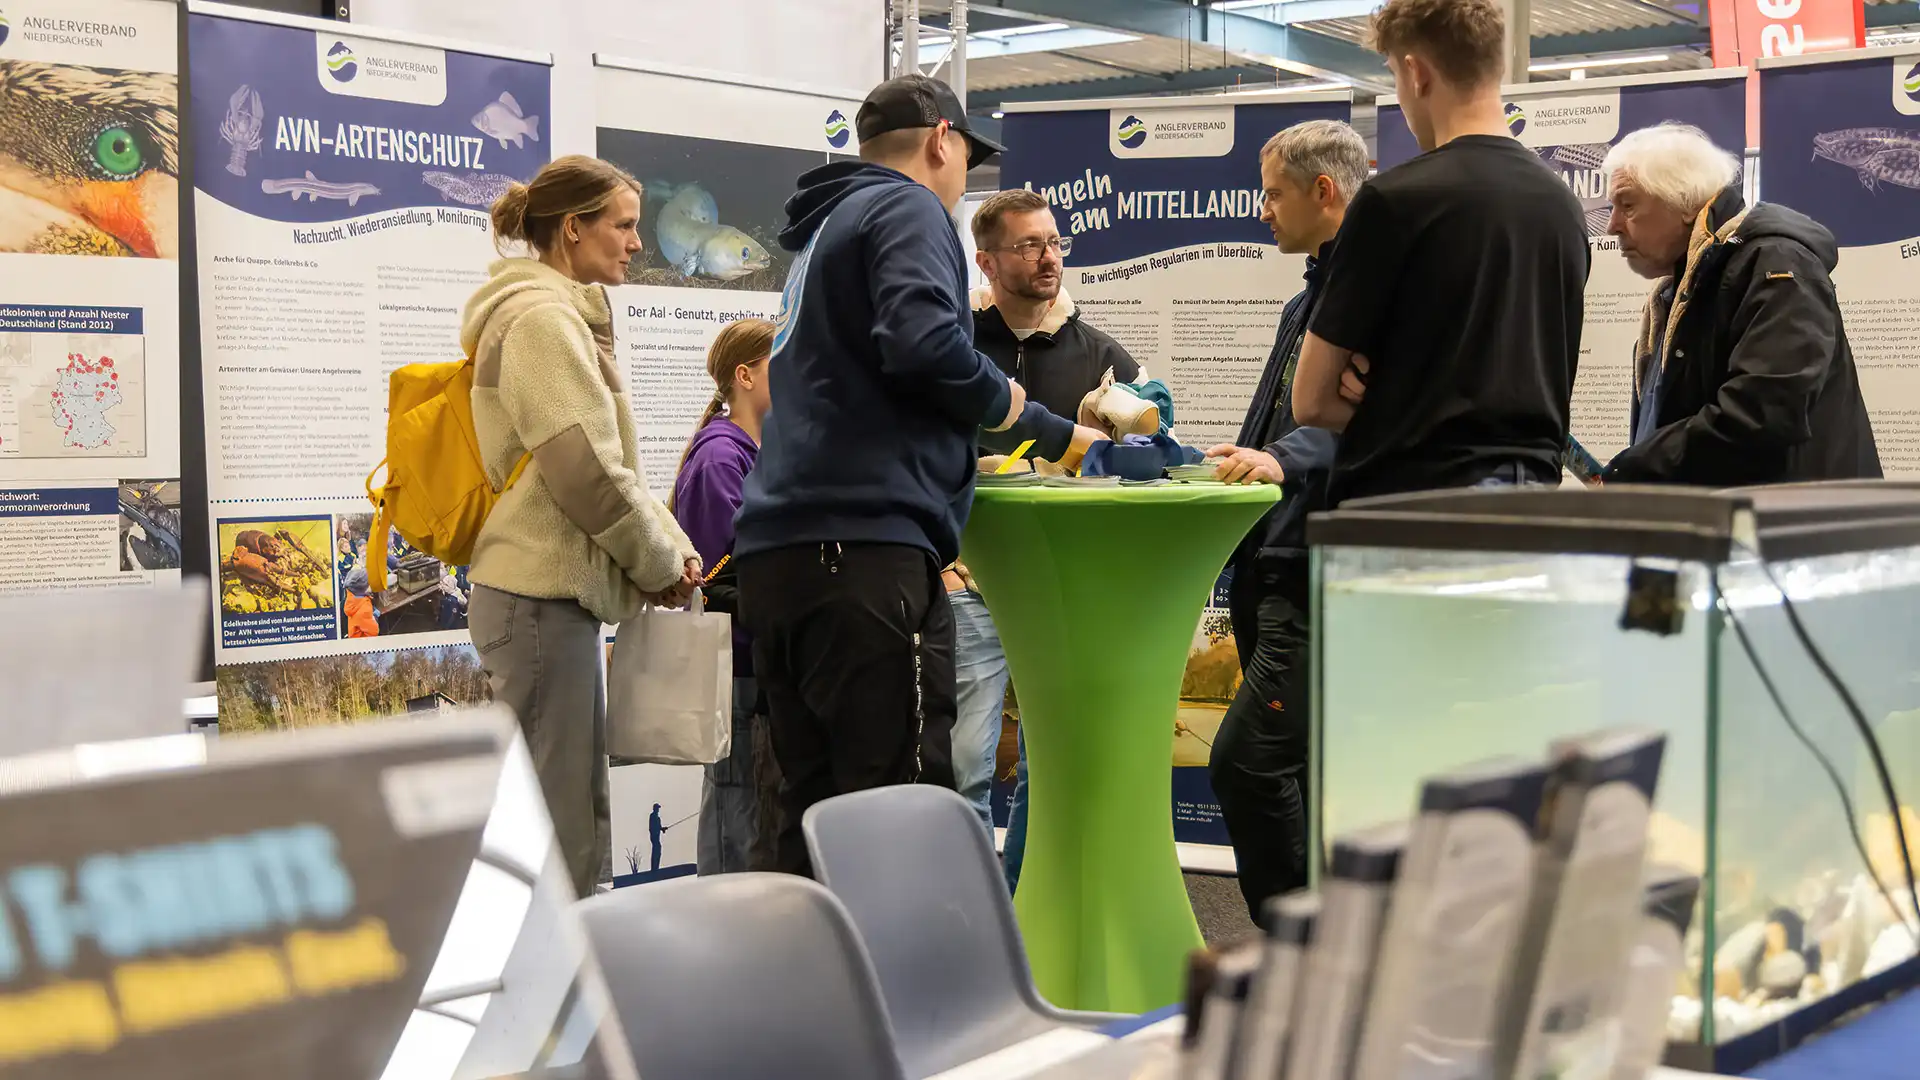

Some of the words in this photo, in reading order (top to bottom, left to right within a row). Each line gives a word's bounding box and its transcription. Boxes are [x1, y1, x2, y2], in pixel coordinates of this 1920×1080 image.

[23, 17, 137, 38] ANGLERVERBAND
[23, 32, 103, 47] NIEDERSACHSEN
[366, 56, 438, 75] ANGLERVERBAND
[366, 68, 417, 82] NIEDERSACHSEN
[1534, 105, 1611, 119] ANGLERVERBAND
[1154, 121, 1226, 132] ANGLERVERBAND
[1533, 118, 1587, 128] NIEDERSACHSEN
[1154, 132, 1204, 140] NIEDERSACHSEN
[275, 116, 485, 170] AVN-ARTENSCHUTZ
[437, 208, 488, 232] Monitoring
[1070, 206, 1110, 235] am
[213, 255, 234, 264] Arche
[274, 259, 303, 267] Edelkrebs
[1081, 272, 1095, 285] Die
[1096, 261, 1149, 283] wichtigsten
[1149, 249, 1200, 269] Regularien
[1202, 247, 1215, 259] im
[1217, 243, 1264, 260] Überblick
[49, 310, 66, 318] und
[69, 310, 98, 318] Anzahl
[101, 311, 129, 319] Nester
[378, 304, 424, 313] Lokalgenetische
[426, 306, 458, 315] Anpassung
[628, 305, 647, 318] Der
[650, 306, 666, 319] Aal
[675, 307, 717, 322] Genutzt,
[0, 319, 55, 328] Deutschland
[58, 320, 85, 330] (Stand
[89, 321, 114, 330] 2012)
[639, 326, 672, 335] Fischdrama
[684, 328, 704, 336] Europa
[631, 343, 656, 352] Spezialist
[270, 366, 300, 374] Gewässer:
[224, 620, 257, 628] Edelkrebse
